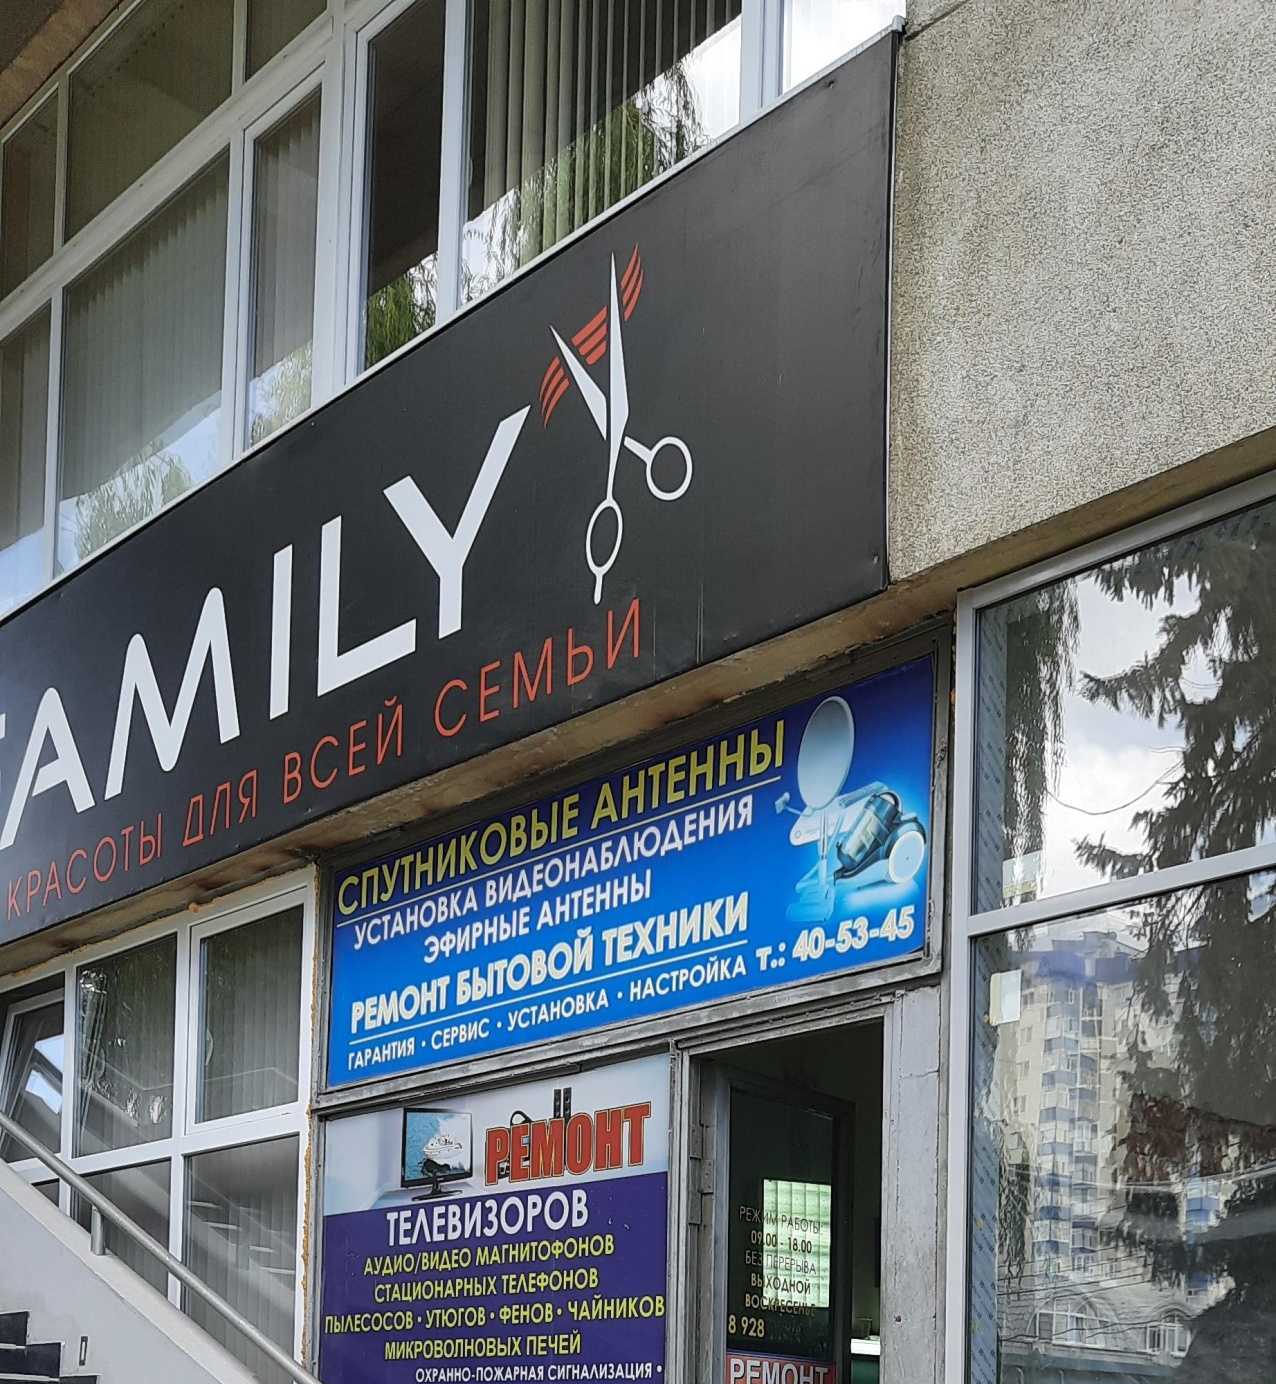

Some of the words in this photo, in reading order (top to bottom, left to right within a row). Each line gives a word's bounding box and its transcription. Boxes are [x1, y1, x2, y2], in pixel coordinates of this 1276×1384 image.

[0, 405, 531, 850] AMILY
[6, 812, 162, 921] КРАСОТЫ
[182, 768, 258, 847] ДЛЯ
[283, 696, 403, 805] ВСЕЙ
[434, 597, 641, 737] СЕМЬИ
[338, 794, 580, 915] СПУТНИКОВЫЕ
[591, 720, 785, 829] АНТЕННЫ
[354, 887, 478, 950] УСТАНОВКА
[486, 795, 753, 907] ВИДЕОНАБЛЮДЕНИЯ
[424, 907, 530, 965] ЭФИРНЫЕ
[537, 870, 651, 930] АНТЕННЫ
[351, 976, 449, 1034] РЕМОНТ
[456, 927, 593, 1006] БЫТОВОЙ
[602, 891, 749, 966] ТЕХНИКИ
[348, 1037, 415, 1070] ГАРАНТИЯ
[431, 1018, 490, 1050] СЕРВИС
[507, 989, 609, 1031] УСТАНОВКА
[630, 955, 747, 1002] НАСТРОЙКА
[792, 905, 915, 962] 40-53-45
[484, 1102, 652, 1187] РЕМОНТ
[386, 1189, 589, 1247] ТЕЛЕВИЗОРОВ
[739, 1206, 778, 1225] РЕЖИМ
[364, 1247, 472, 1277] АУДИО/ВИДЕО
[476, 1234, 615, 1267] МАГНИТОФОНОВ
[745, 1250, 763, 1267] БЕЗ
[766, 1253, 817, 1275] ПЕРЕРЫВА
[751, 1230, 777, 1248] 09.00
[787, 1237, 812, 1254] 18.00
[374, 1275, 498, 1303] СТАЦИОНАРНЫХ
[502, 1268, 599, 1295] ТЕЛЕФОНОВ
[751, 1273, 811, 1295] ВЫХОДНОЙ
[324, 1312, 414, 1335] ПЫЛЕСОСОВ
[425, 1306, 486, 1330] УТЮГОВ
[499, 1302, 553, 1325] ФЕНОВ
[567, 1295, 666, 1321] ЧАЙНИКОВ
[728, 1314, 737, 1334] 8
[741, 1316, 765, 1338] 928
[384, 1337, 522, 1360] МИКРОВОЛНОВЫХ
[527, 1329, 582, 1354] ПЕЧЕЙ
[415, 1365, 544, 1383] ОХРАННО-ПОЖАРНАЯ
[547, 1363, 652, 1382] СИГНАЛИЗАЦИЯ
